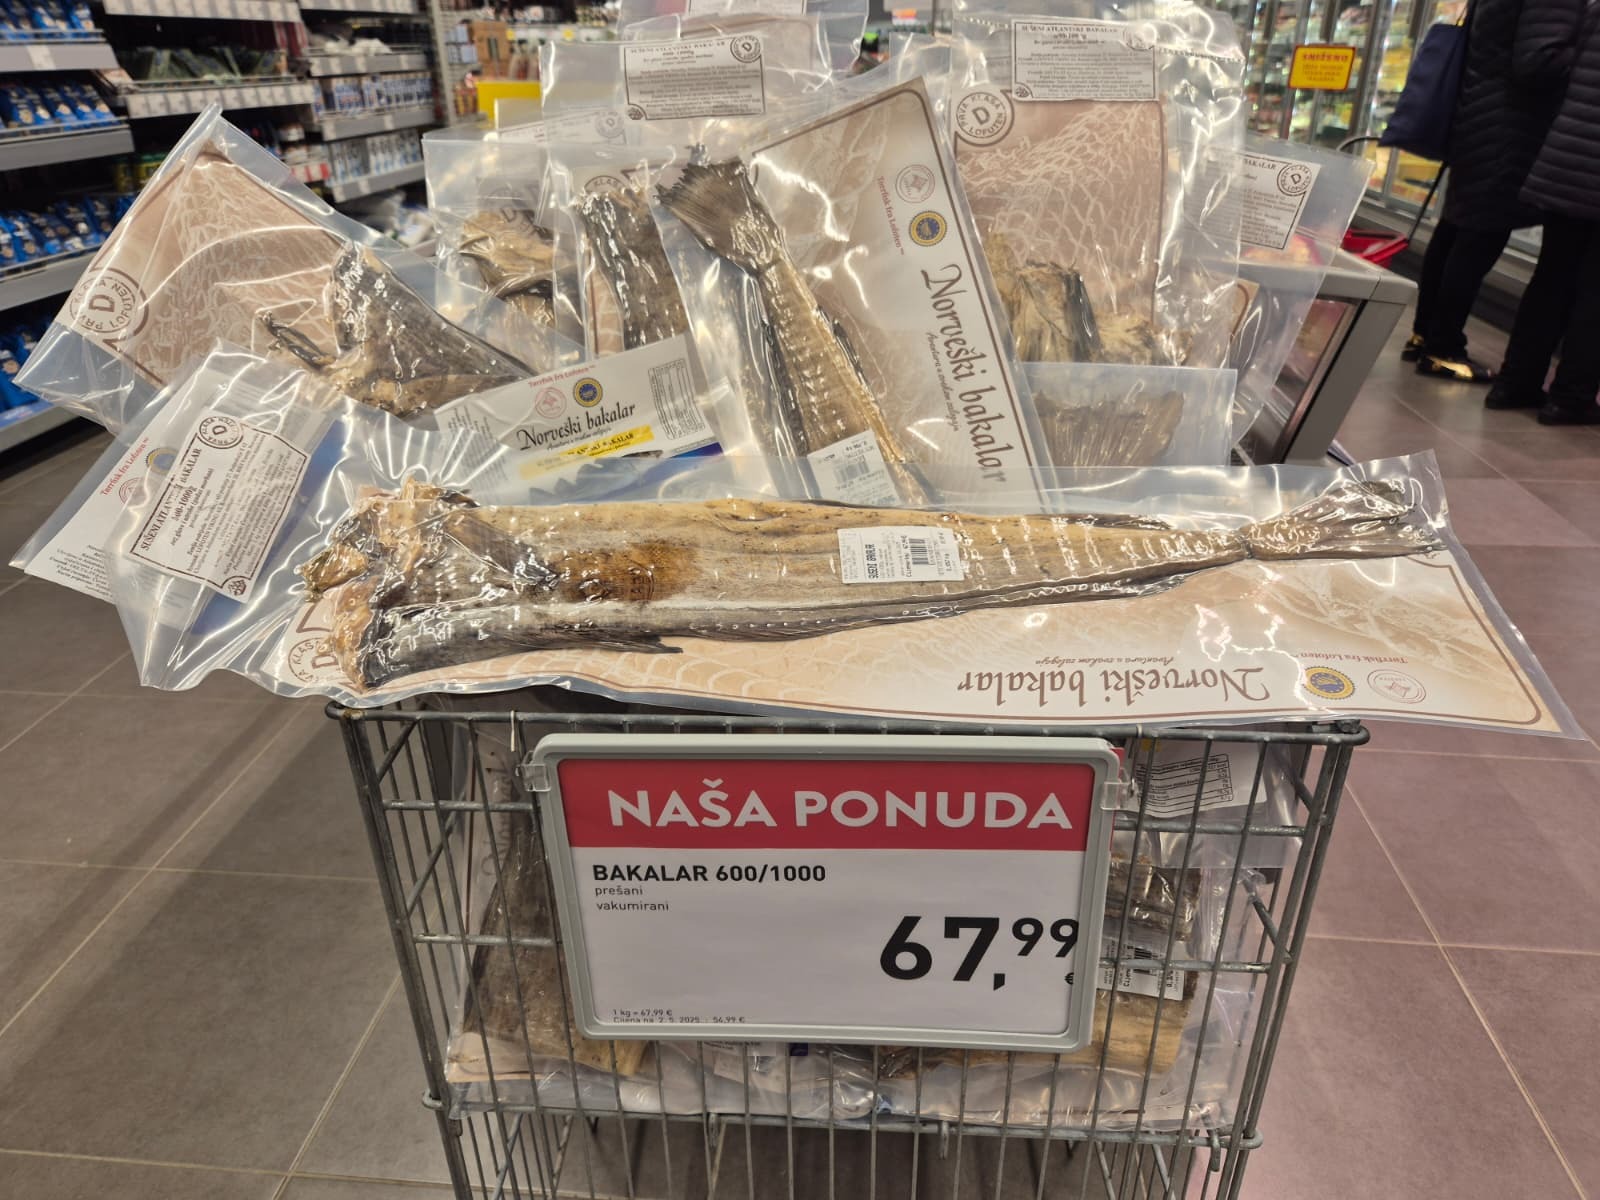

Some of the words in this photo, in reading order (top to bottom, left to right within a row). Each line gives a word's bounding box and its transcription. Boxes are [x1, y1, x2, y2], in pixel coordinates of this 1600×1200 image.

[971, 106, 990, 126] D
[1290, 173, 1302, 185] D
[88, 294, 115, 312] D
[921, 263, 987, 382] Norveški
[958, 385, 1015, 483] bakalar
[212, 425, 228, 435] D
[516, 414, 582, 450] Norveški
[586, 401, 636, 430] bakalar
[957, 669, 1088, 708] bakalar
[1100, 667, 1271, 707] Norveški
[607, 778, 777, 828] NAŠA
[795, 790, 1072, 830] PONUDA
[593, 864, 709, 882] BAKALAR
[715, 864, 826, 882] 600/1000
[594, 884, 643, 898] prešani
[596, 900, 669, 911] vakumirani
